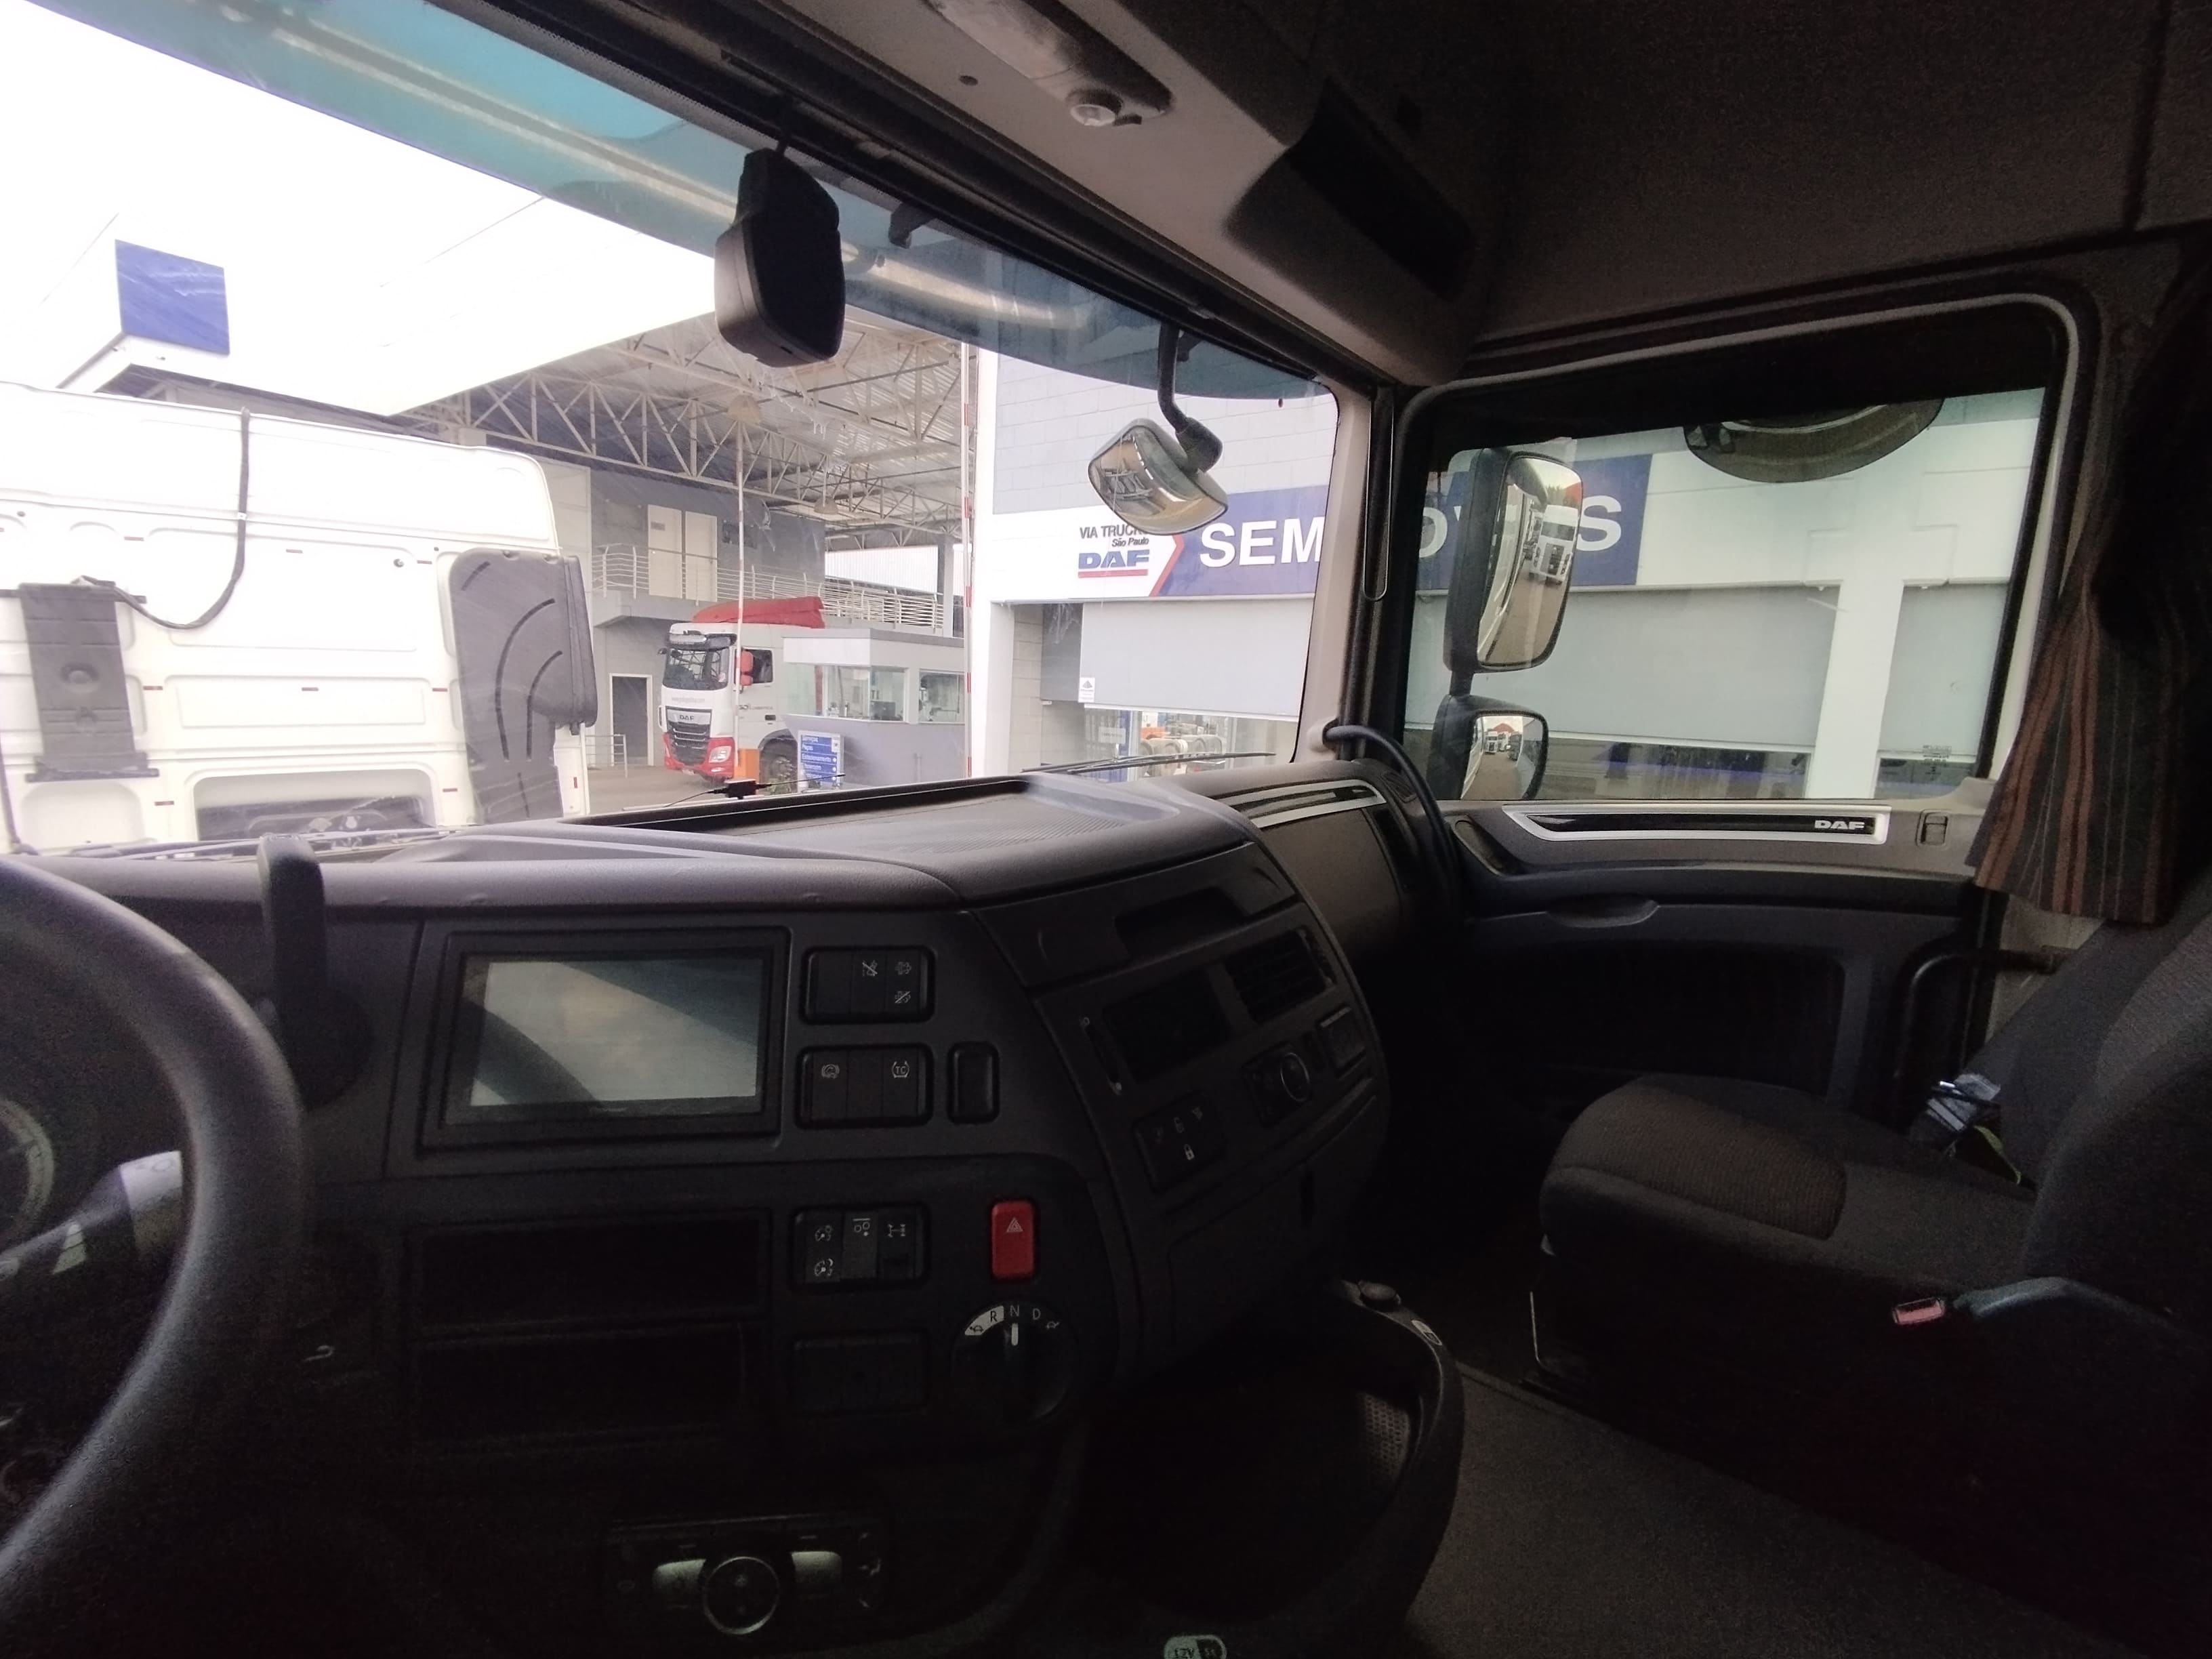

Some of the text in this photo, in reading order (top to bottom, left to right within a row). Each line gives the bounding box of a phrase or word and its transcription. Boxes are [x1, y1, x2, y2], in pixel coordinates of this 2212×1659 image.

[1080, 527, 1098, 539] VIA
[1111, 537, 1149, 547] São Paulo
[1078, 550, 1150, 569] DAF
[1815, 820, 1865, 830] DAF
[990, 1305, 1041, 1322] R N D
